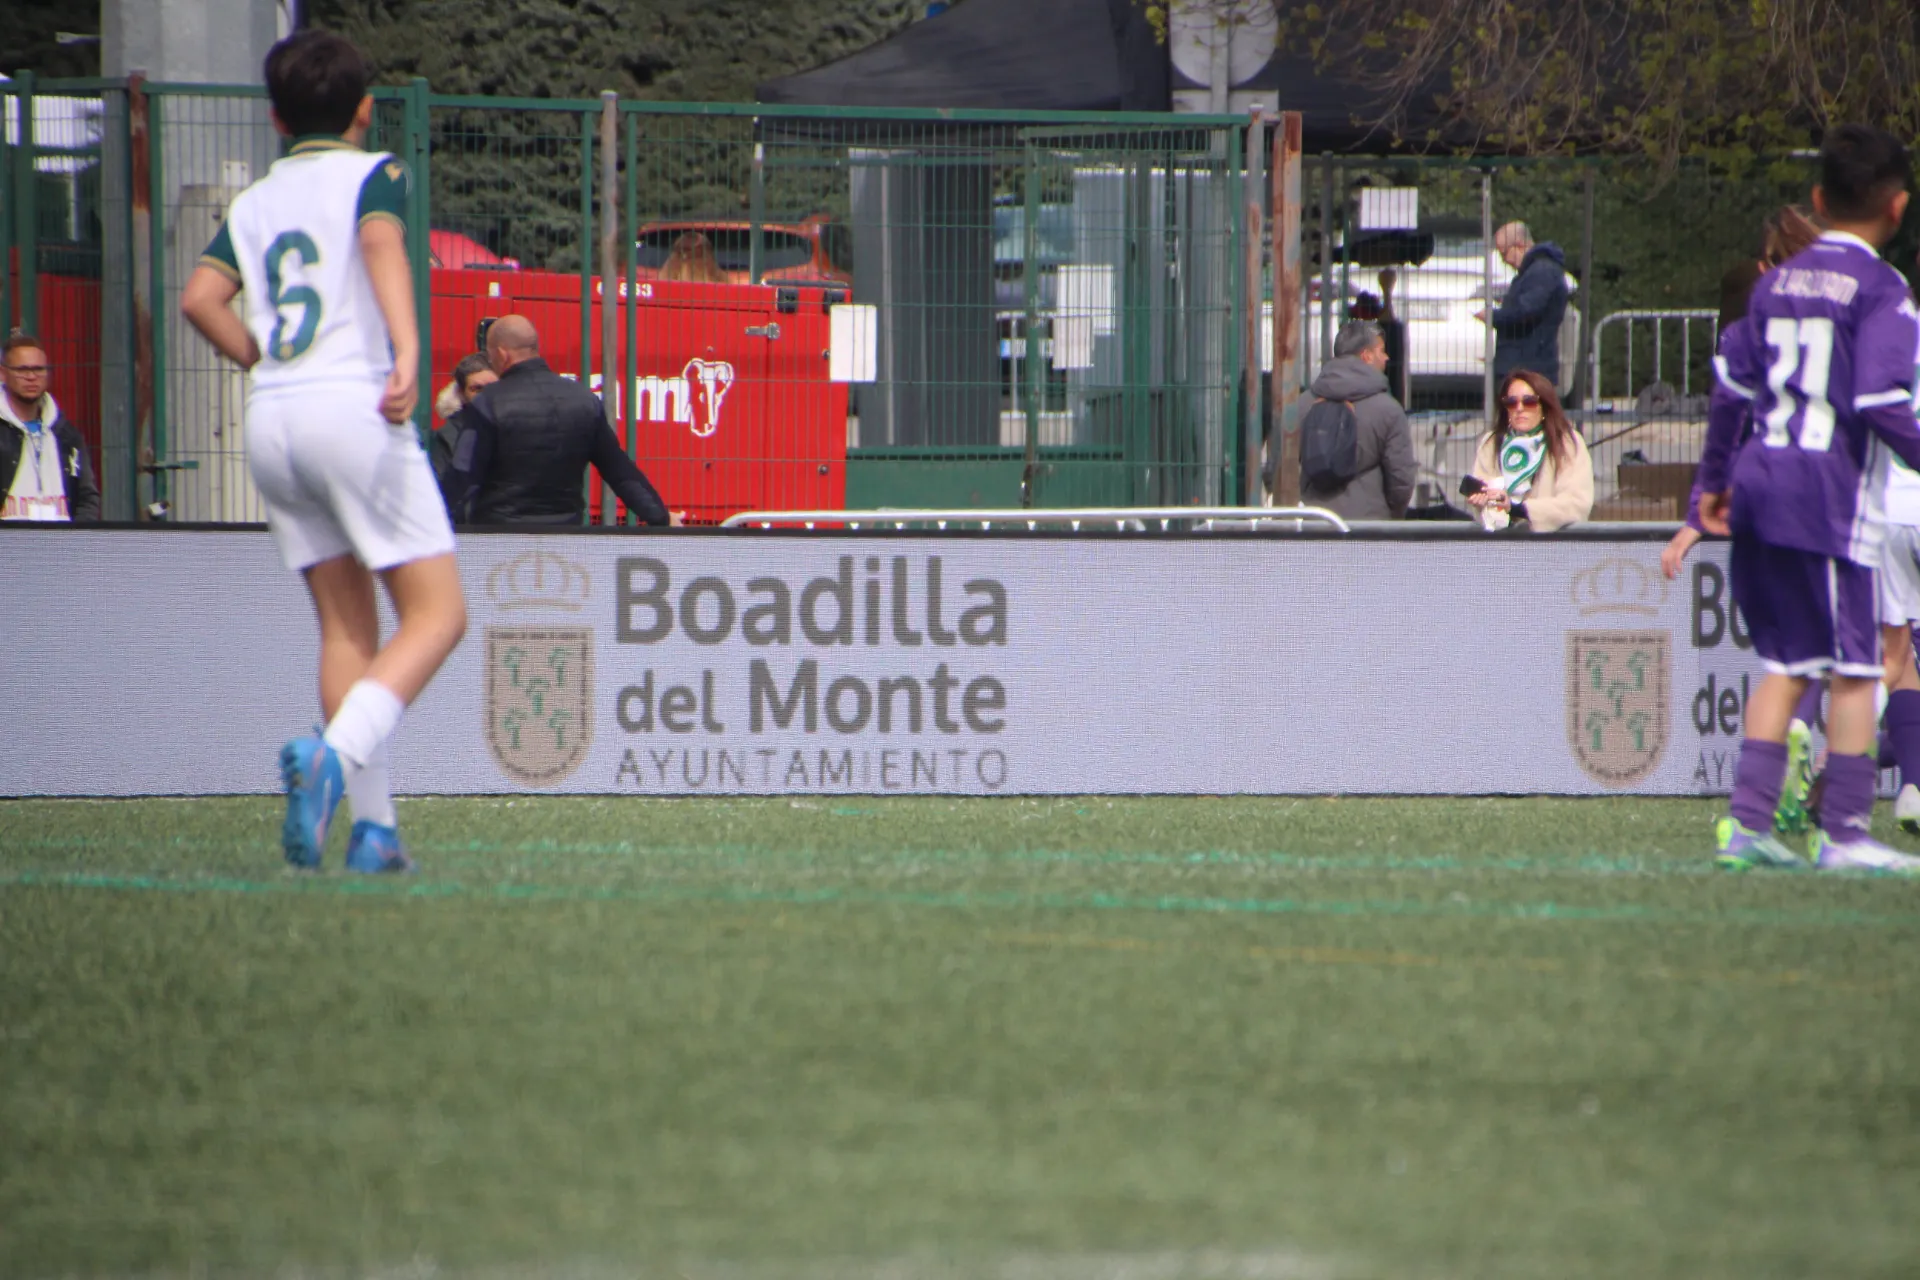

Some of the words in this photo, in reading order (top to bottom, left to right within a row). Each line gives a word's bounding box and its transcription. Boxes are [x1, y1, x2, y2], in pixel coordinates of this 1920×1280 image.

[265, 230, 322, 361] 6
[616, 555, 1007, 646] Boadilla
[616, 669, 724, 733] del
[749, 659, 1006, 734] Monte
[615, 749, 1008, 788] AYUNTAMIENTO
